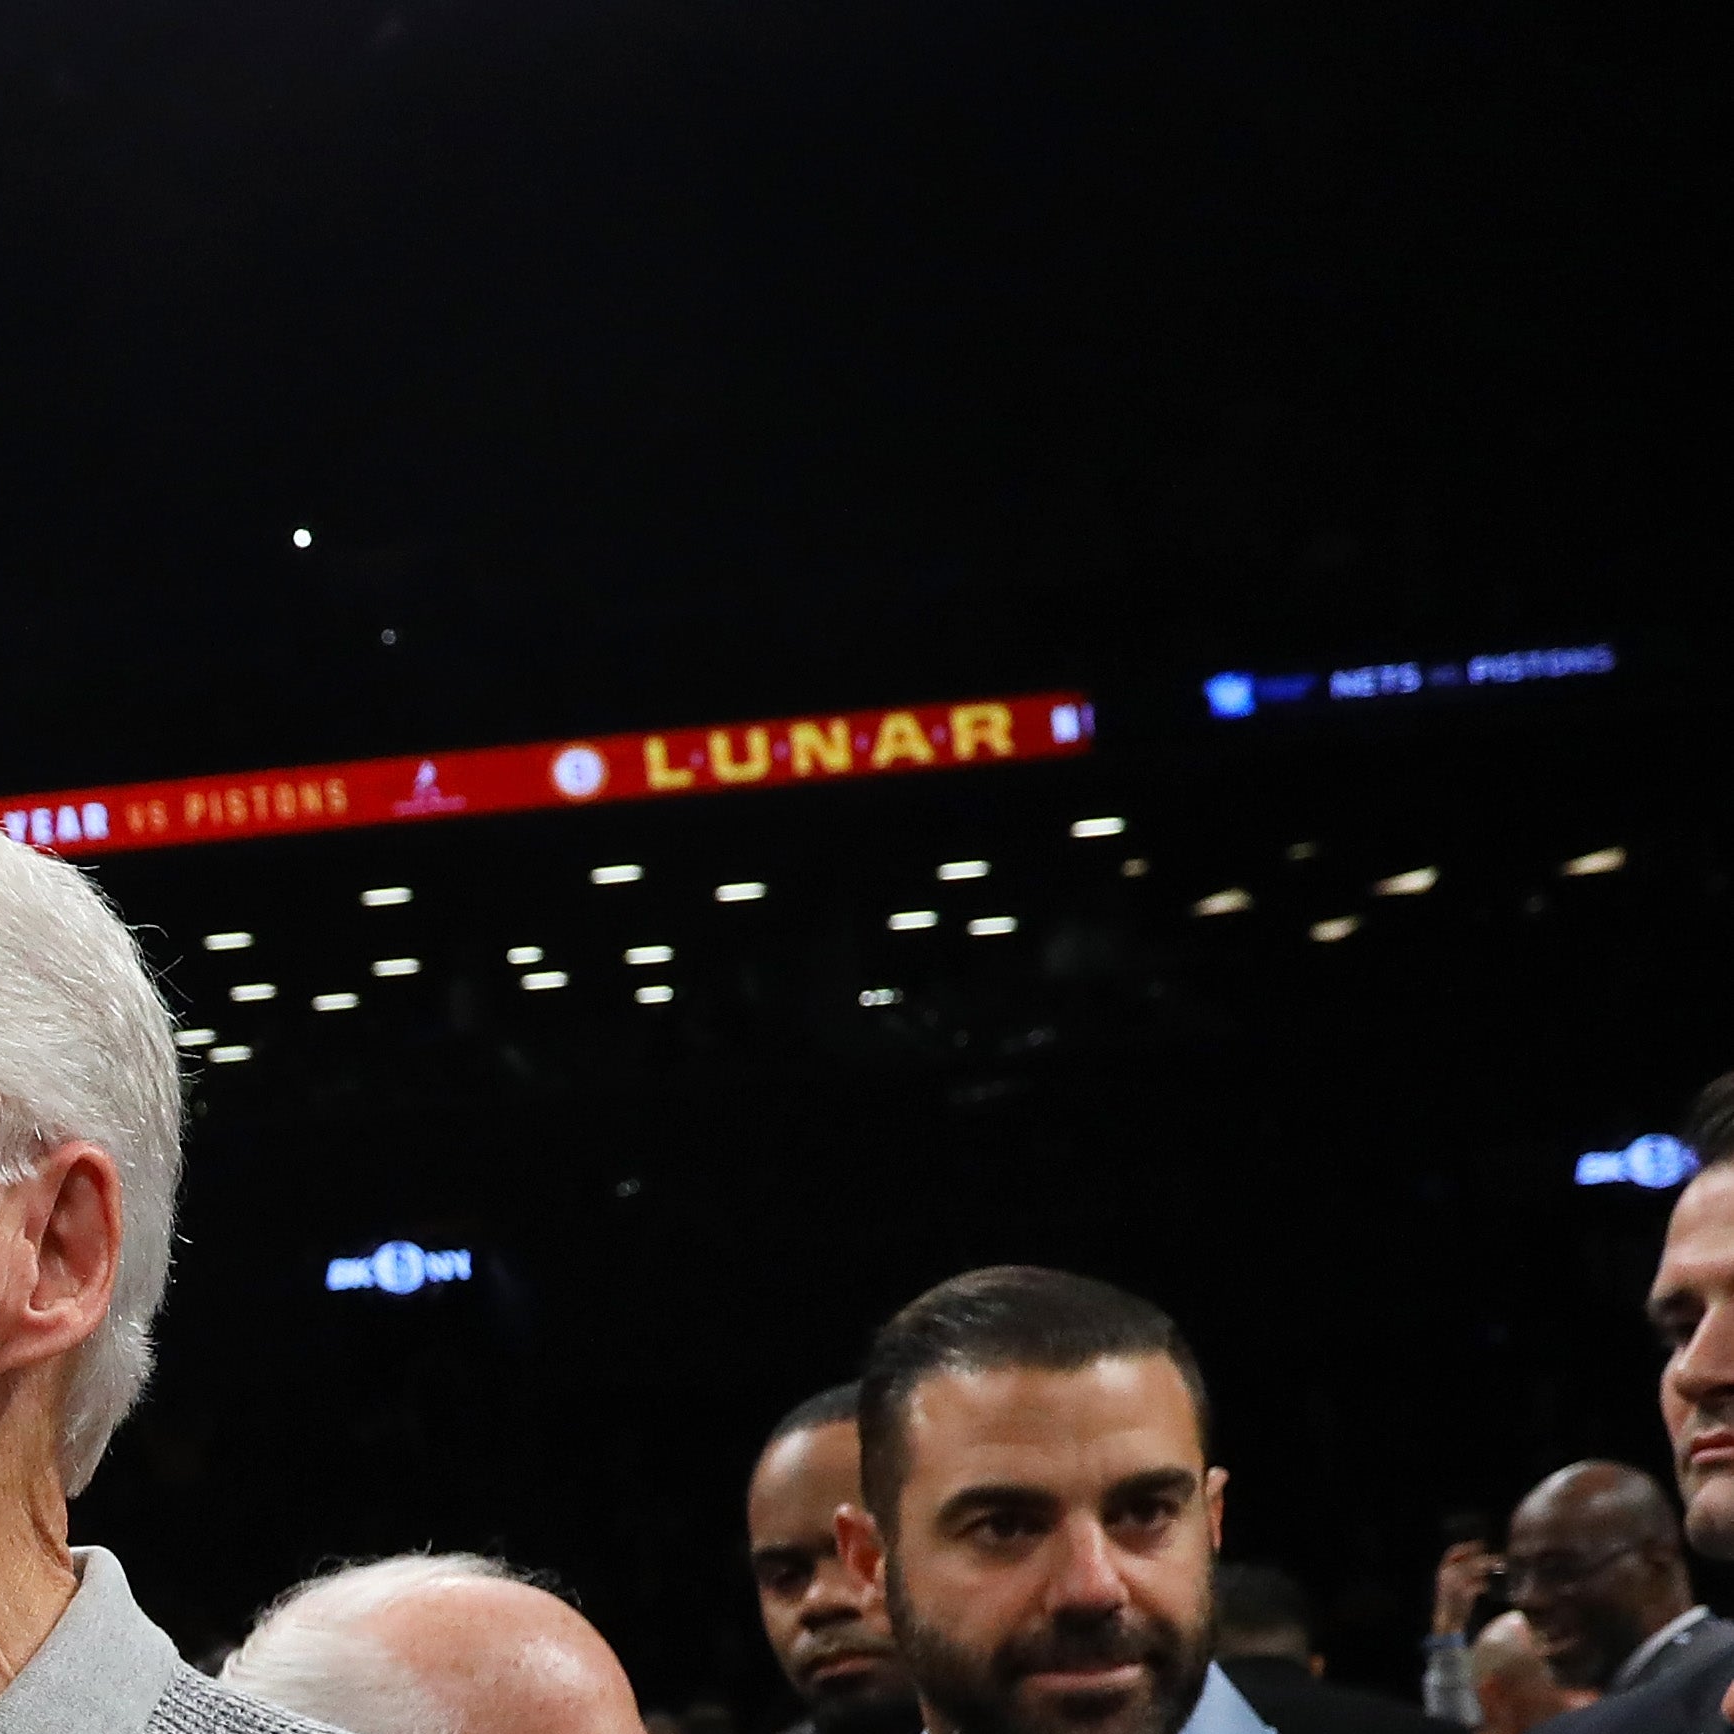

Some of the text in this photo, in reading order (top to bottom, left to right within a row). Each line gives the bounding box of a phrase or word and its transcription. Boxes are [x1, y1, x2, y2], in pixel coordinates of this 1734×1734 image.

[3, 802, 110, 846] YEAR
[125, 800, 168, 835] VS
[183, 778, 348, 829] PISTONS
[644, 703, 1016, 790] LUNAR
